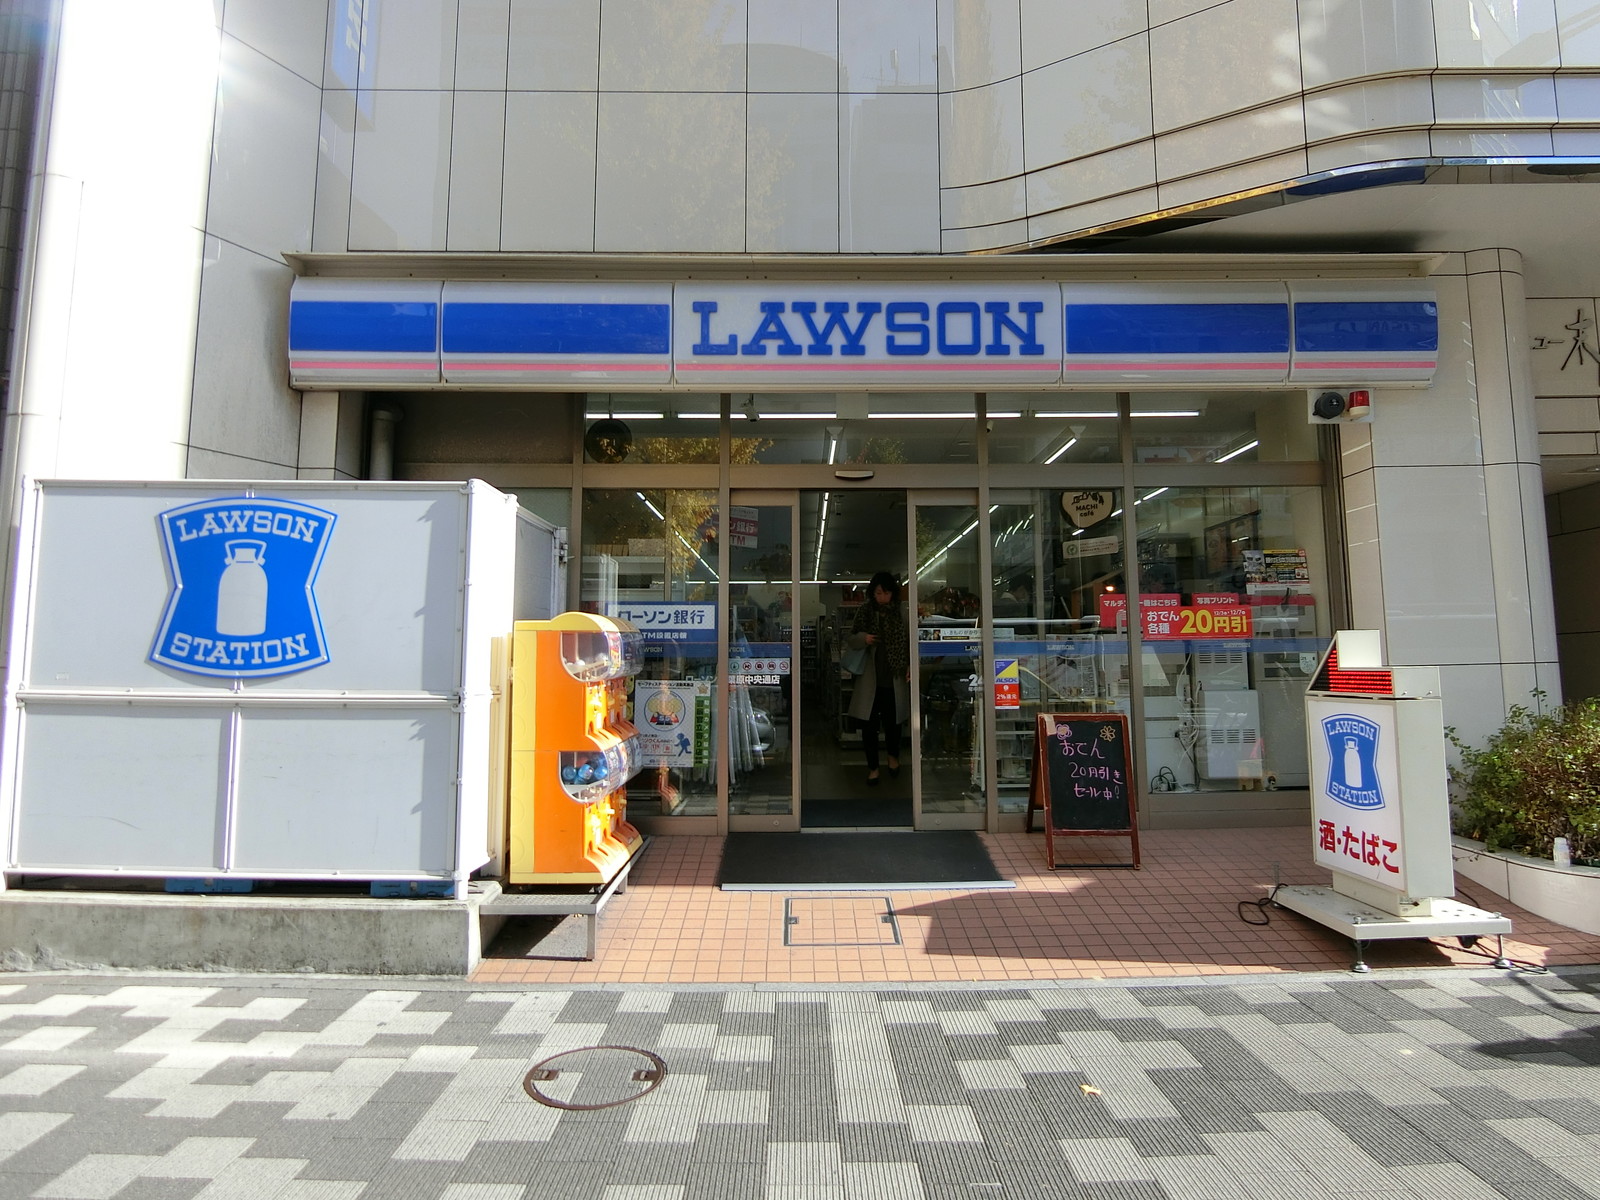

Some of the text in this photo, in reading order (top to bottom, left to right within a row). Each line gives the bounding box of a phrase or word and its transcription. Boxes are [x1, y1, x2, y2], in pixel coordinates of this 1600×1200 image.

[692, 301, 1044, 356] LAWSON
[176, 510, 319, 543] LAWSON
[618, 610, 705, 625] ローソン銀行
[1147, 611, 1179, 622] おでん
[1148, 622, 1170, 634] 各種
[1180, 609, 1248, 634] 20円引
[170, 632, 310, 665] STATION
[1327, 720, 1375, 741] LAWSON
[1059, 738, 1106, 759] おでん
[1068, 762, 1124, 785] 20円引き
[1331, 781, 1379, 804] STATION
[1319, 819, 1399, 874] 酒・たばこ
